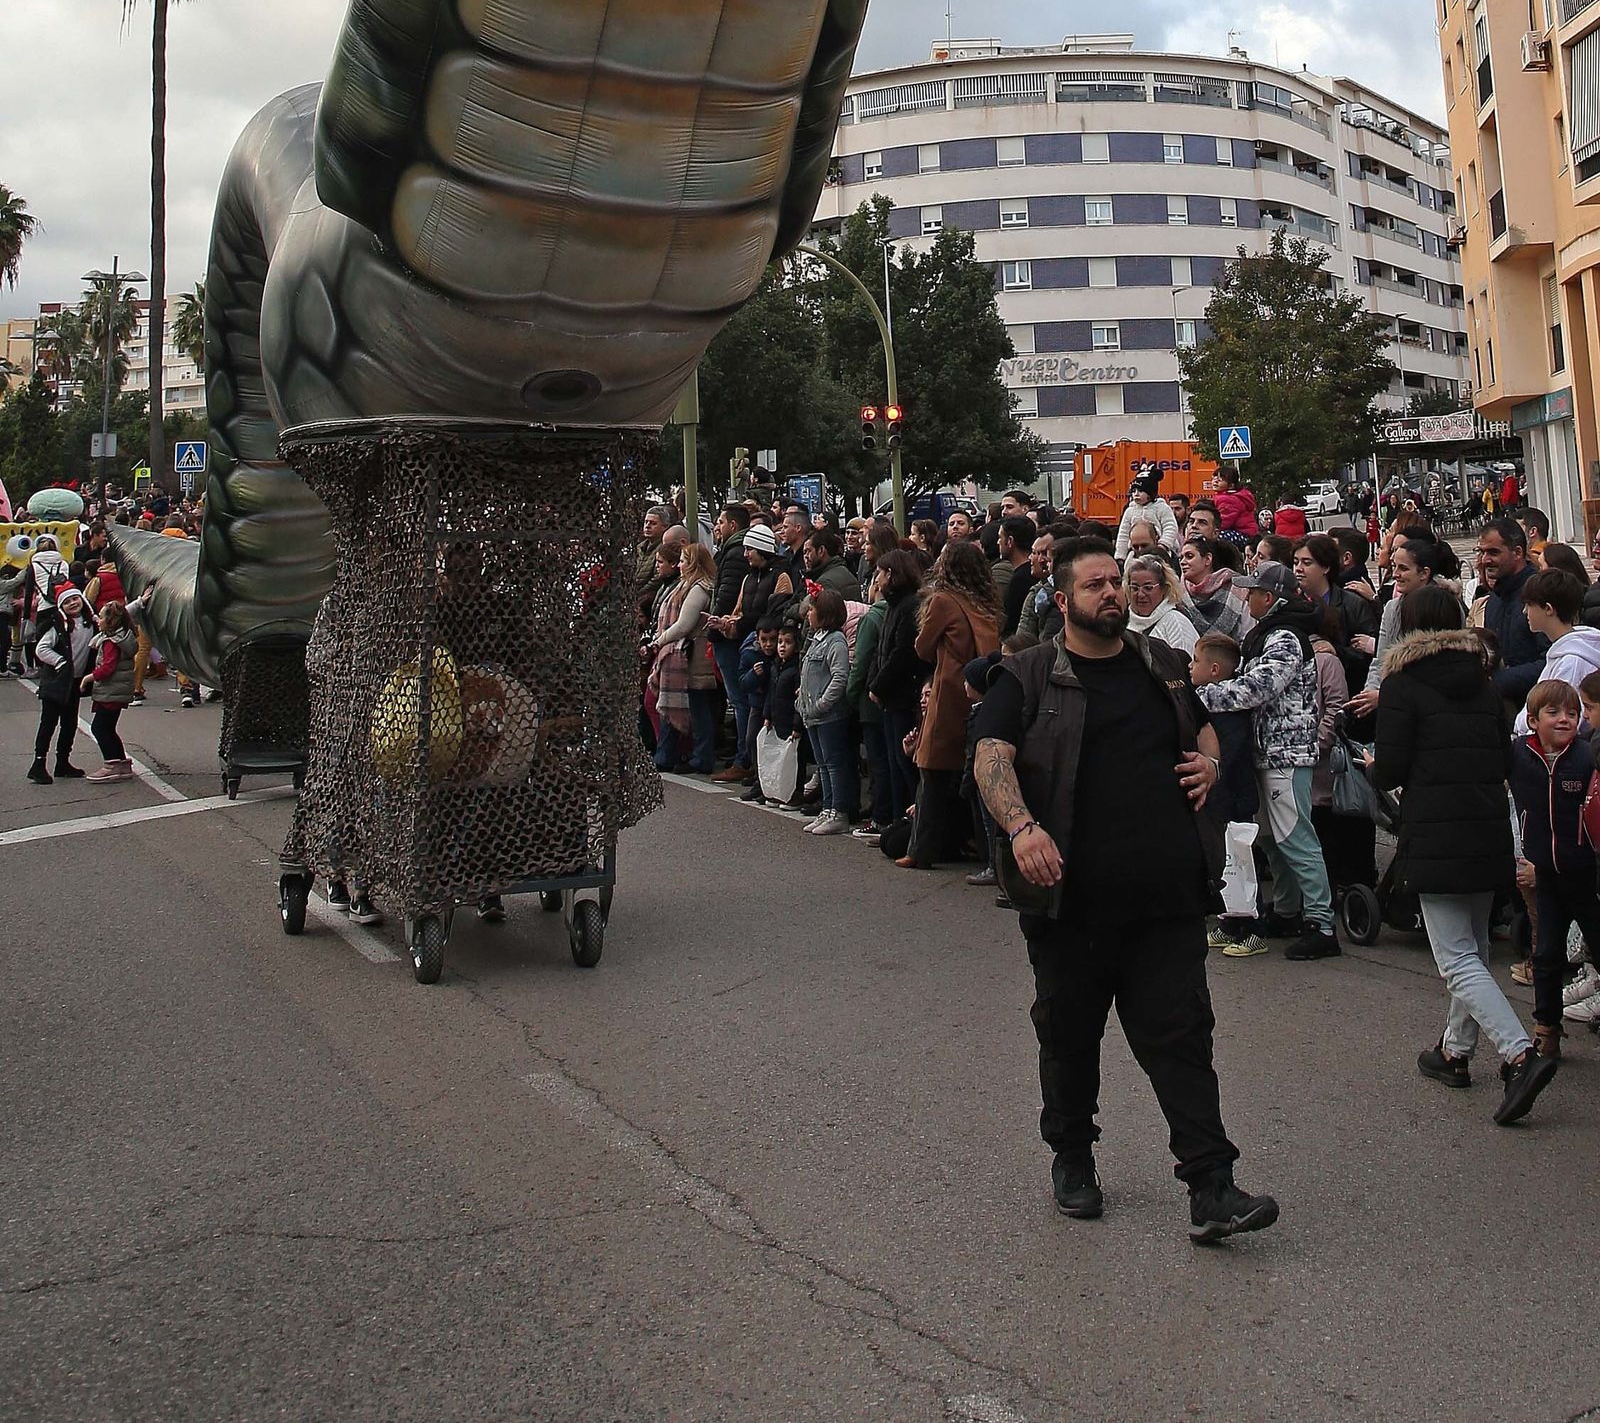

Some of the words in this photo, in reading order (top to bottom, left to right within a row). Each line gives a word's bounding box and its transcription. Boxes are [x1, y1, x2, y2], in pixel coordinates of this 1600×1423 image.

[1020, 371, 1059, 383] edificio
[1059, 357, 1138, 382] Centro
[1384, 425, 1419, 440] Gallego
